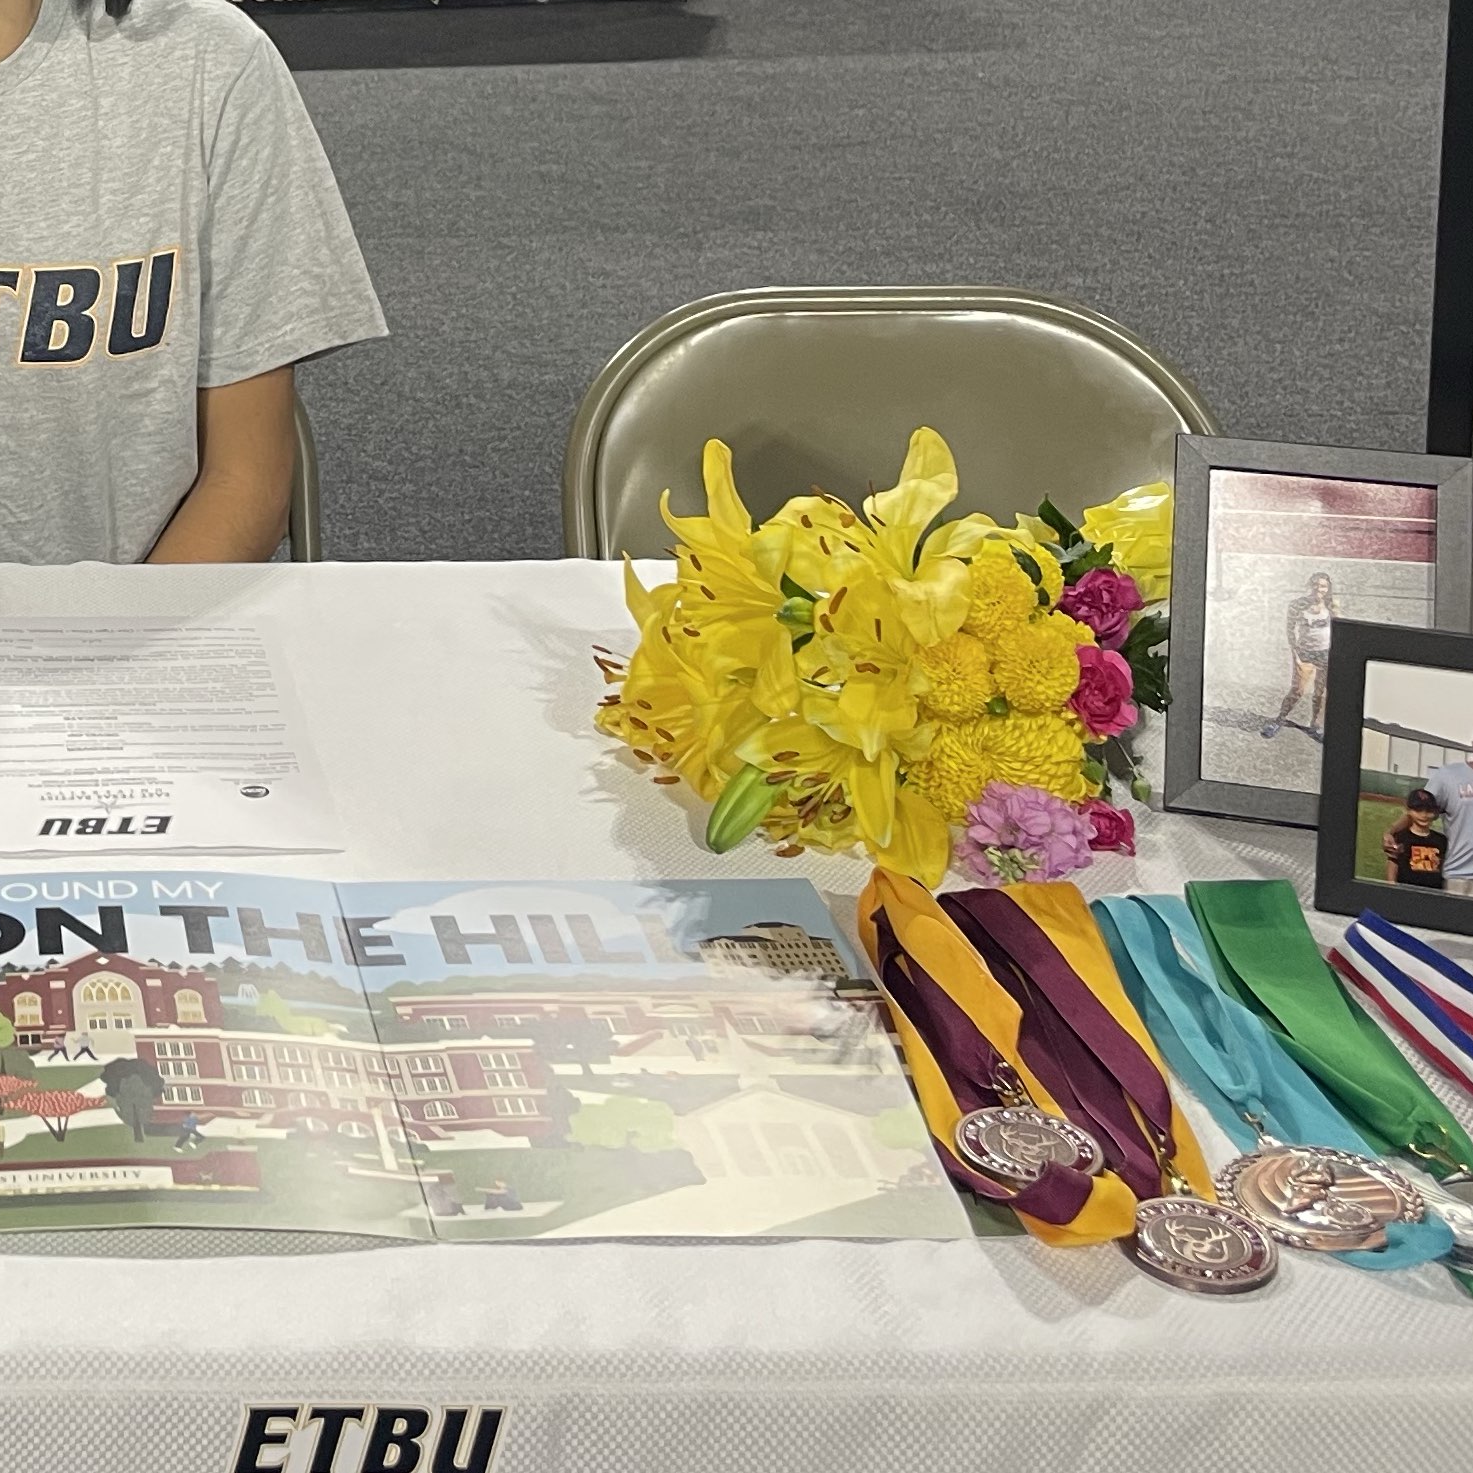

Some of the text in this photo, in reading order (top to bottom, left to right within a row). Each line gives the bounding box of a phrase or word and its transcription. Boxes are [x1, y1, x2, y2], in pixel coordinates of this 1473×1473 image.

[37, 815, 174, 836] ETBU
[152, 880, 225, 901] MY
[159, 904, 408, 969] THE
[28, 1169, 142, 1183] UNIVERSITY
[227, 1403, 508, 1473] ETBU
